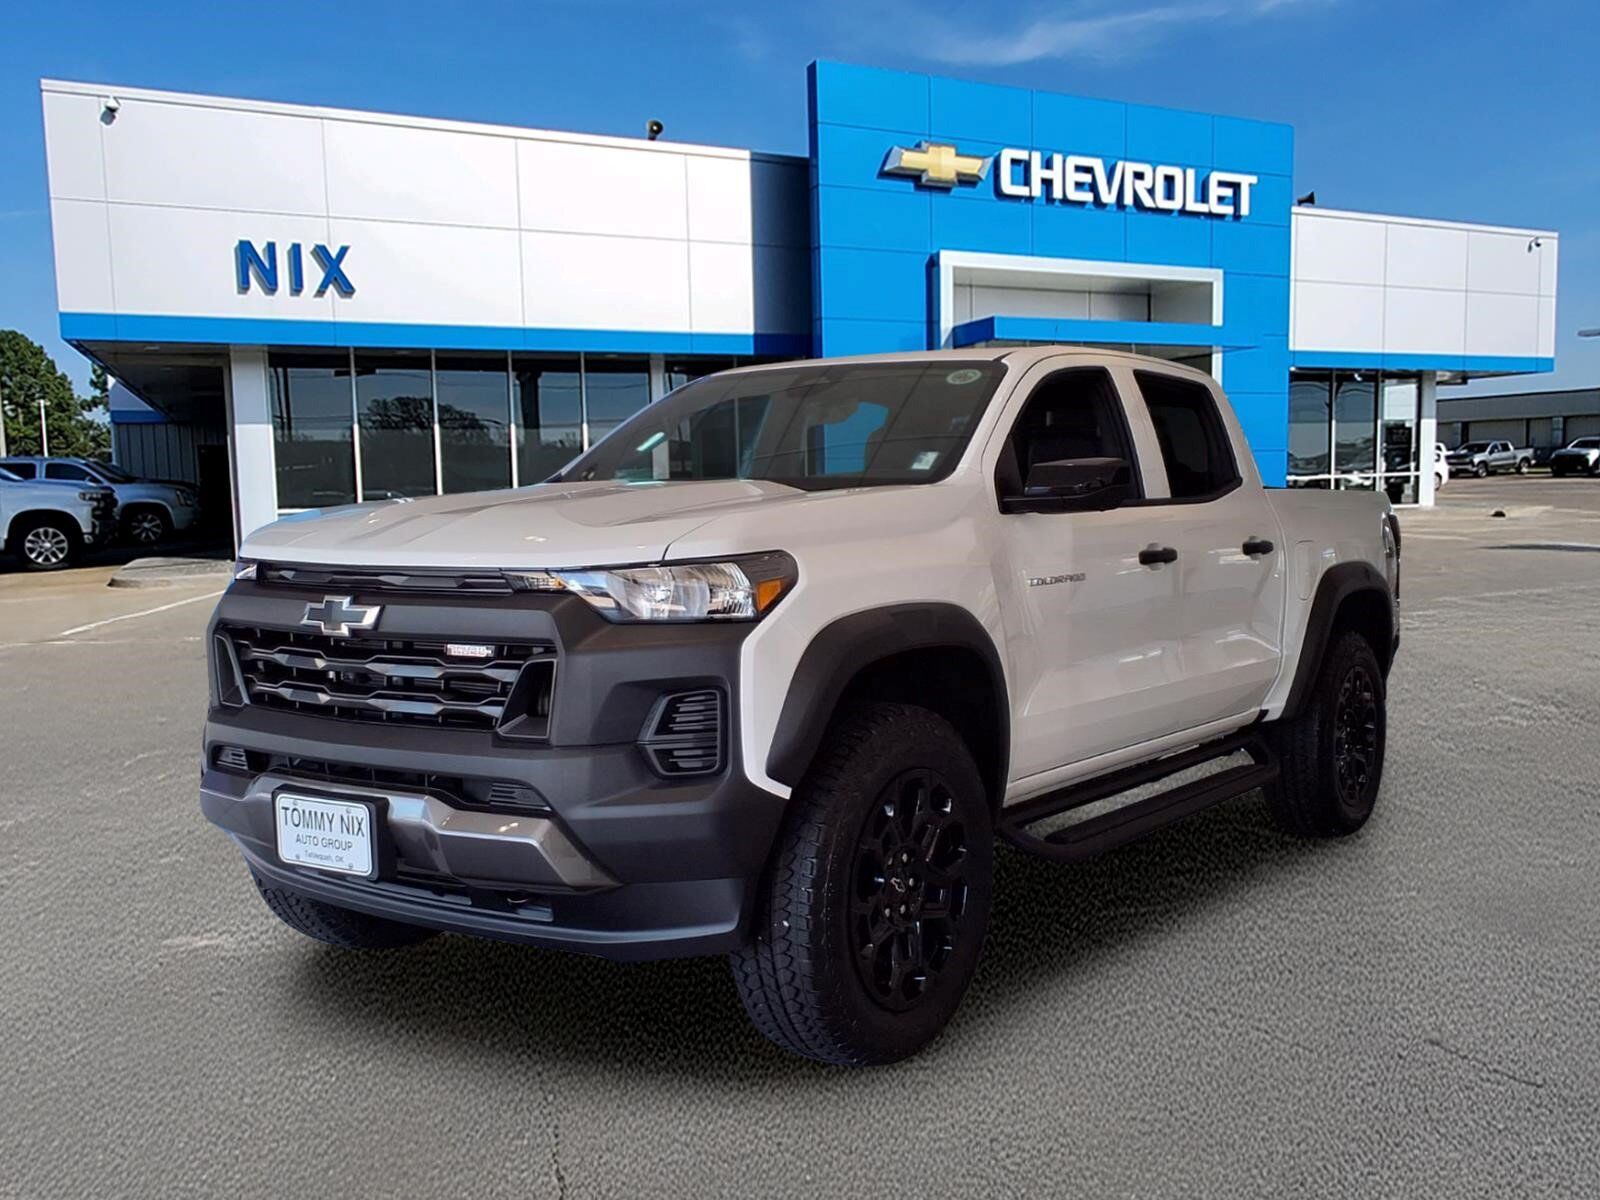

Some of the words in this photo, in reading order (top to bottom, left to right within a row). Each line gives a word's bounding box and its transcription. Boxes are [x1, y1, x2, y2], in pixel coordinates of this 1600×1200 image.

[997, 147, 1258, 219] CHEVROLET
[234, 239, 356, 298] NIX
[281, 806, 335, 833] TOMMY
[340, 814, 365, 838] NIX
[295, 833, 319, 847] AUTO
[321, 837, 353, 852] GROUP
